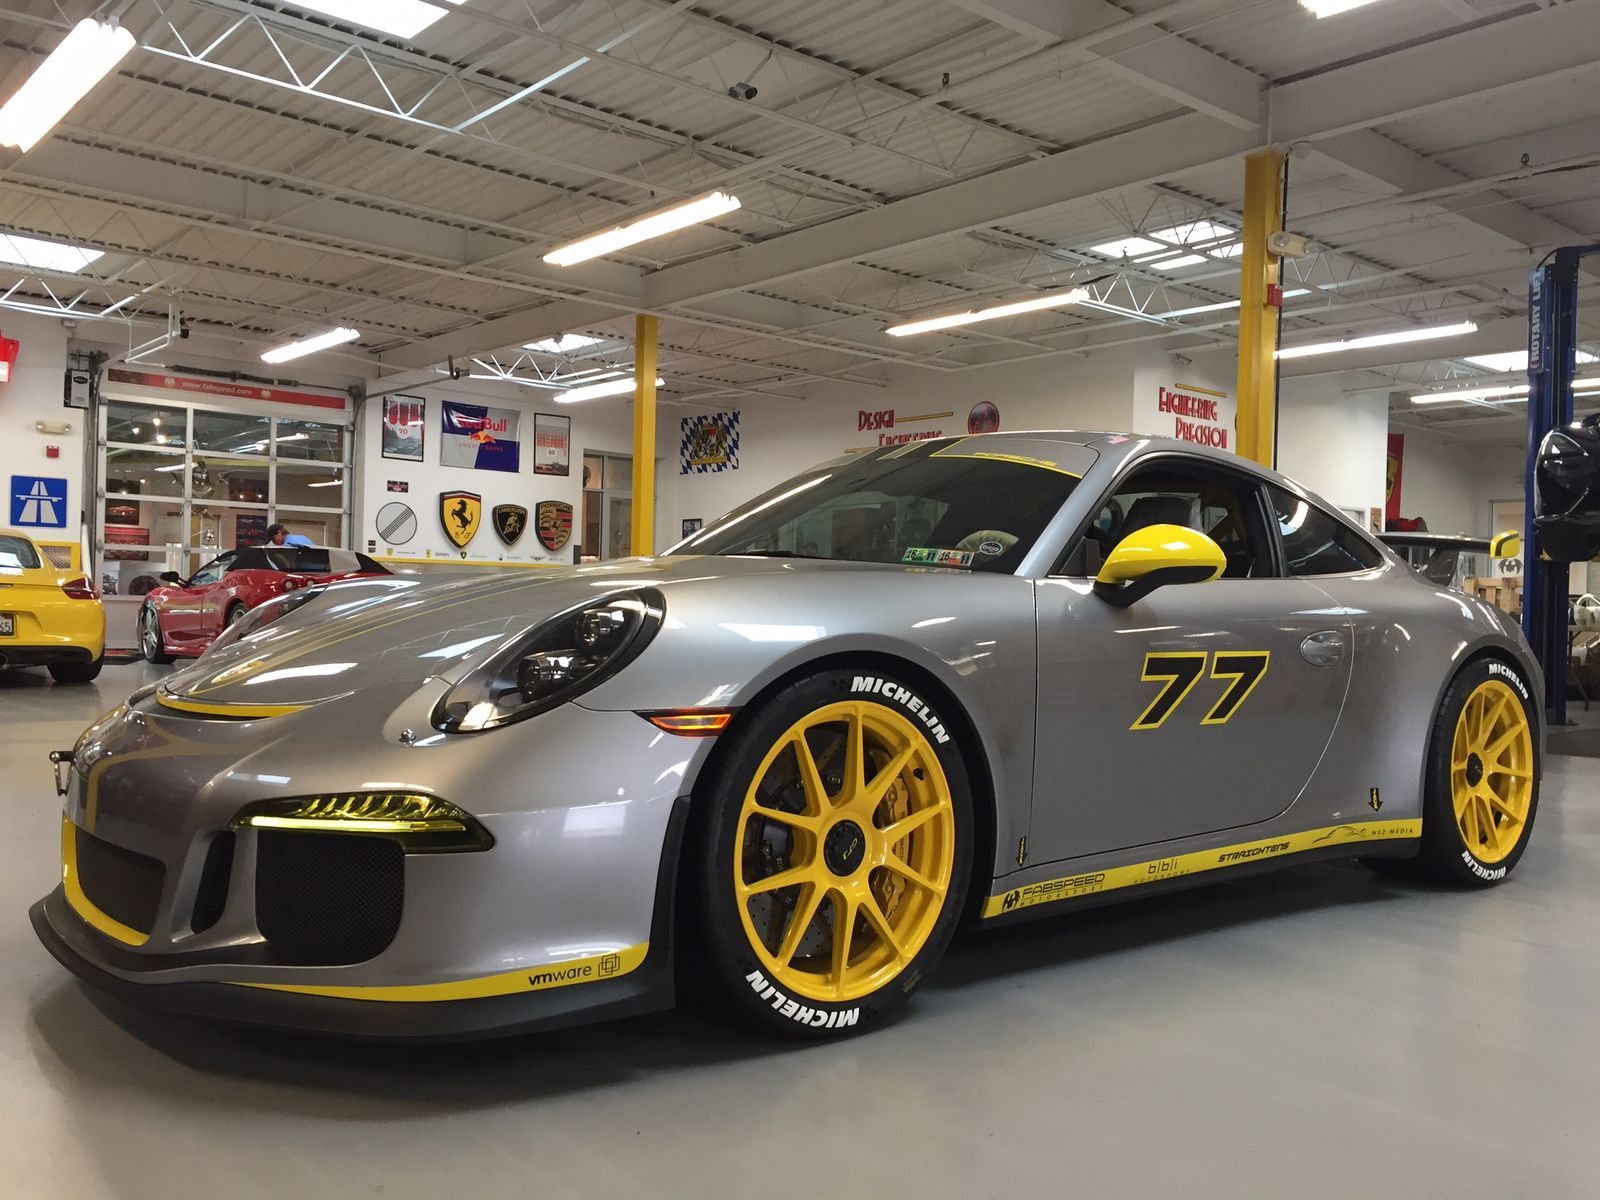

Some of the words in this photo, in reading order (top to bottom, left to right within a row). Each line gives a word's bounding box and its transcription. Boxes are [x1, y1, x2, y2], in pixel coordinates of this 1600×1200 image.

[1531, 306, 1541, 362] ROTARY
[1158, 386, 1218, 422] ENGINEERING
[483, 417, 508, 432] Bull
[857, 409, 895, 432] DESIGN
[1175, 416, 1228, 449] PRECISION
[906, 549, 918, 561] 16
[940, 551, 951, 562] 16
[1128, 650, 1271, 731] 77
[1488, 663, 1529, 700] MICHELIN
[850, 676, 950, 744] MICHELIN
[1461, 850, 1506, 880] MICHELIN
[1021, 873, 1105, 898] FABSPEED
[528, 965, 592, 986] vmware
[745, 969, 860, 1028] MICHELIN
